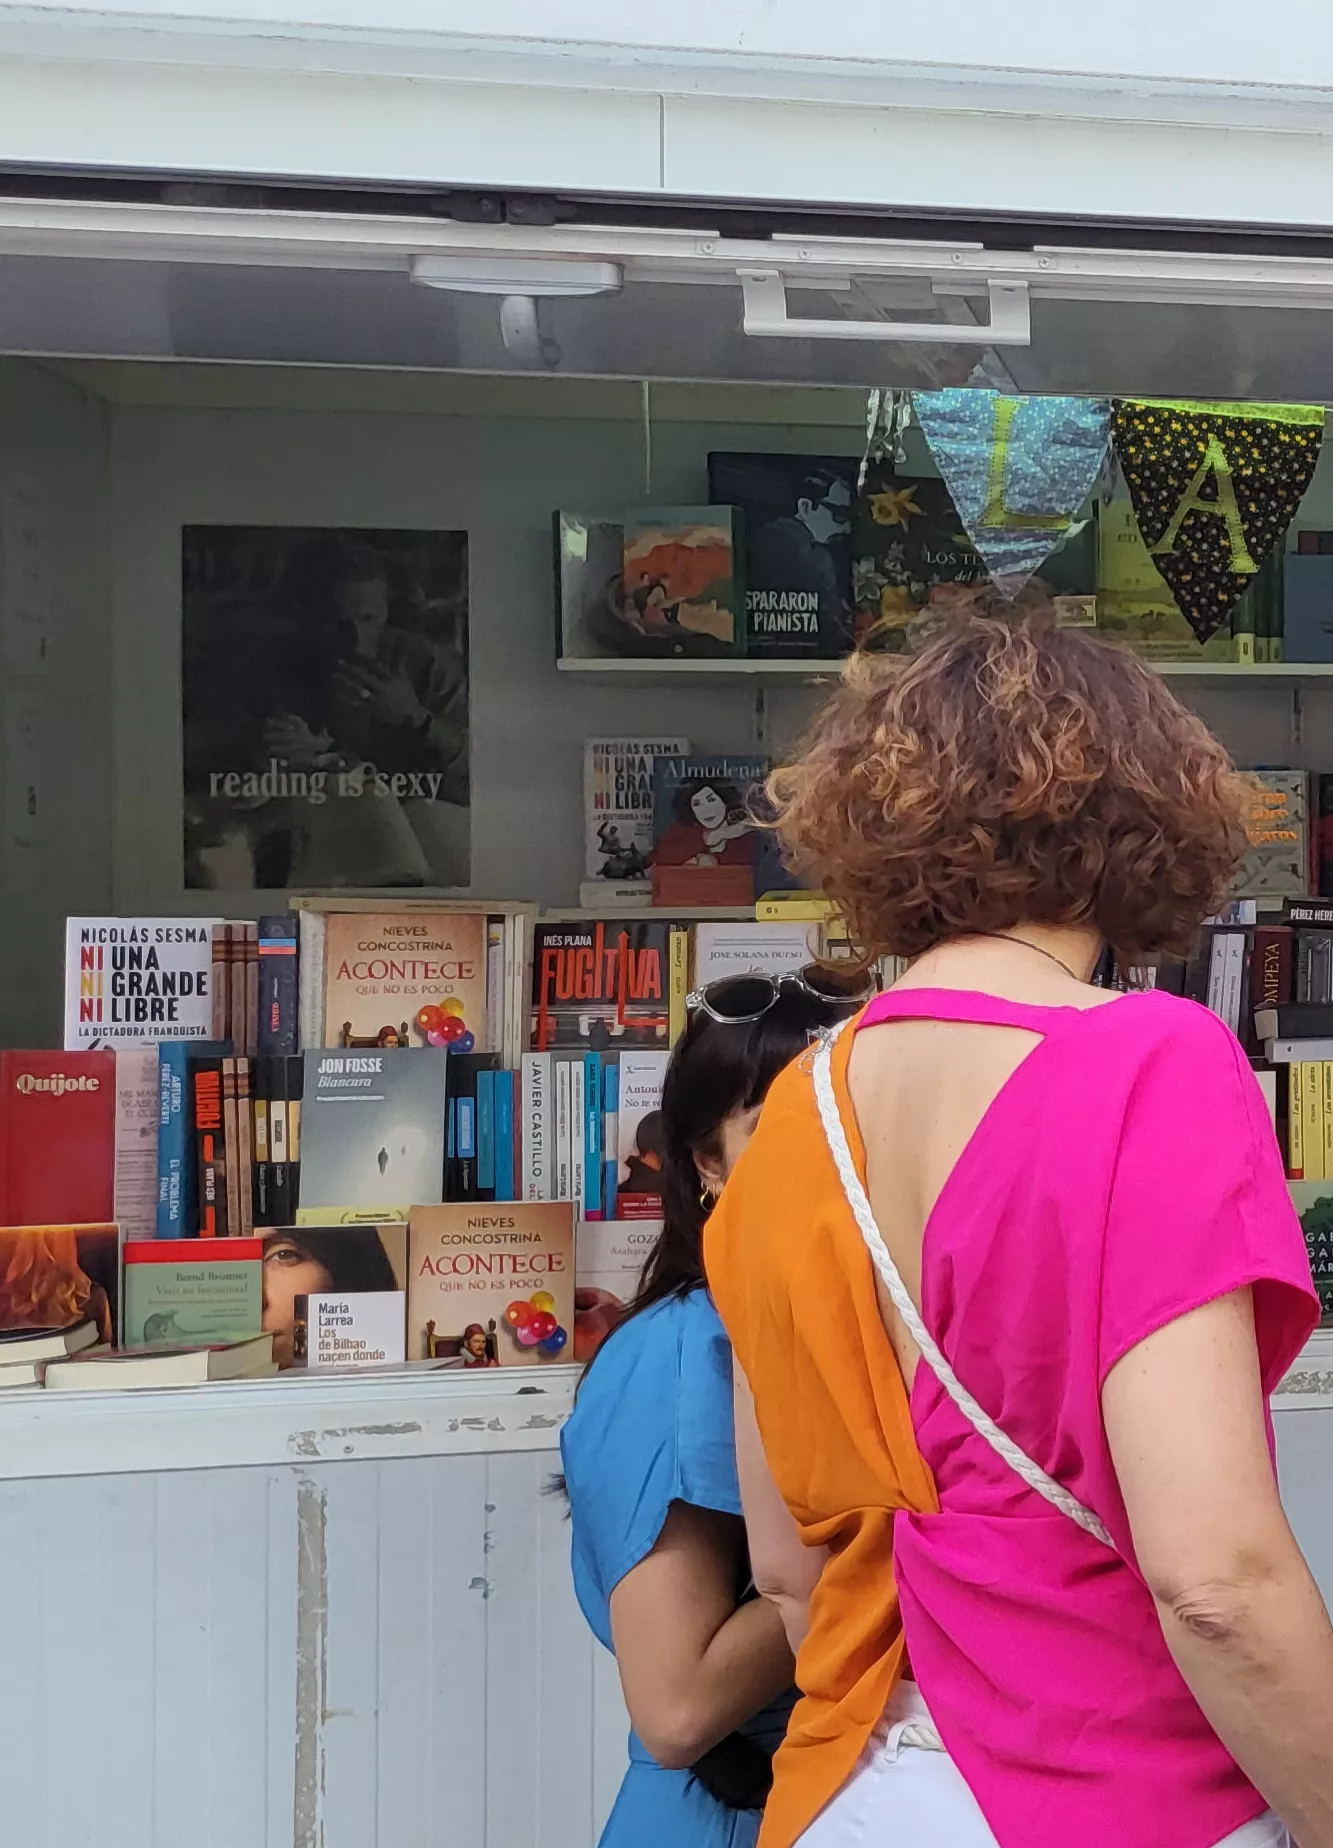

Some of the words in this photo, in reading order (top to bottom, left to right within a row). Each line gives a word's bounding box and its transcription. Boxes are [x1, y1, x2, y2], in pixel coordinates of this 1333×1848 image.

[614, 756, 647, 774] UNA
[663, 758, 762, 779] Almudena
[209, 758, 328, 804] reading
[337, 768, 364, 797] is
[374, 770, 443, 801] sexy
[1290, 907, 1313, 921] PÉREZ
[81, 925, 149, 944] NICOLÁS
[155, 927, 208, 943] SESMA
[383, 926, 429, 937] NIEVES
[357, 941, 454, 952] CONCOSTRINA
[543, 934, 562, 946] INÉS
[563, 935, 593, 946] PLANA
[80, 946, 103, 970] NI
[111, 946, 160, 971] UNA
[336, 959, 475, 981] ACONTECE
[541, 949, 662, 999] FUGITIVA
[80, 972, 103, 996] NI
[111, 972, 208, 997] GRANDE
[355, 984, 379, 995] QUE
[384, 984, 400, 995] NO
[404, 984, 418, 995] ES
[421, 984, 455, 995] POCO
[80, 998, 103, 1022] NI
[111, 998, 179, 1023] LIBRE
[78, 1027, 90, 1037] LA
[93, 1026, 145, 1037] DICTADURA
[149, 1026, 207, 1037] FRANQUISTA
[319, 1057, 344, 1073] JON
[350, 1057, 383, 1073] FOSSE
[16, 1073, 100, 1097] Quijote
[318, 1076, 372, 1088] Blancura
[531, 1061, 542, 1108] JAVIER
[160, 1063, 171, 1125] PÉREZ-REVERTE
[171, 1074, 181, 1114] ARTURO
[625, 1099, 639, 1107] No
[531, 1112, 543, 1178] CASTILLO
[169, 1159, 180, 1169] EL
[160, 1176, 169, 1203] FINAL
[169, 1171, 181, 1221] PROBLEMA
[468, 1217, 515, 1228] NIEVES
[441, 1232, 542, 1246] CONCOSTRINA
[418, 1252, 565, 1276] ACONTECE
[176, 1271, 204, 1282] Bernd
[440, 1281, 464, 1292] QUE
[468, 1280, 486, 1290] NO
[491, 1280, 505, 1290] ES
[509, 1278, 544, 1289] POCO
[318, 1302, 349, 1314] María
[318, 1316, 353, 1326] Larrea
[318, 1328, 336, 1338] Los
[318, 1339, 331, 1350] de
[334, 1338, 366, 1350] Bilbao
[353, 1350, 385, 1361] donde
